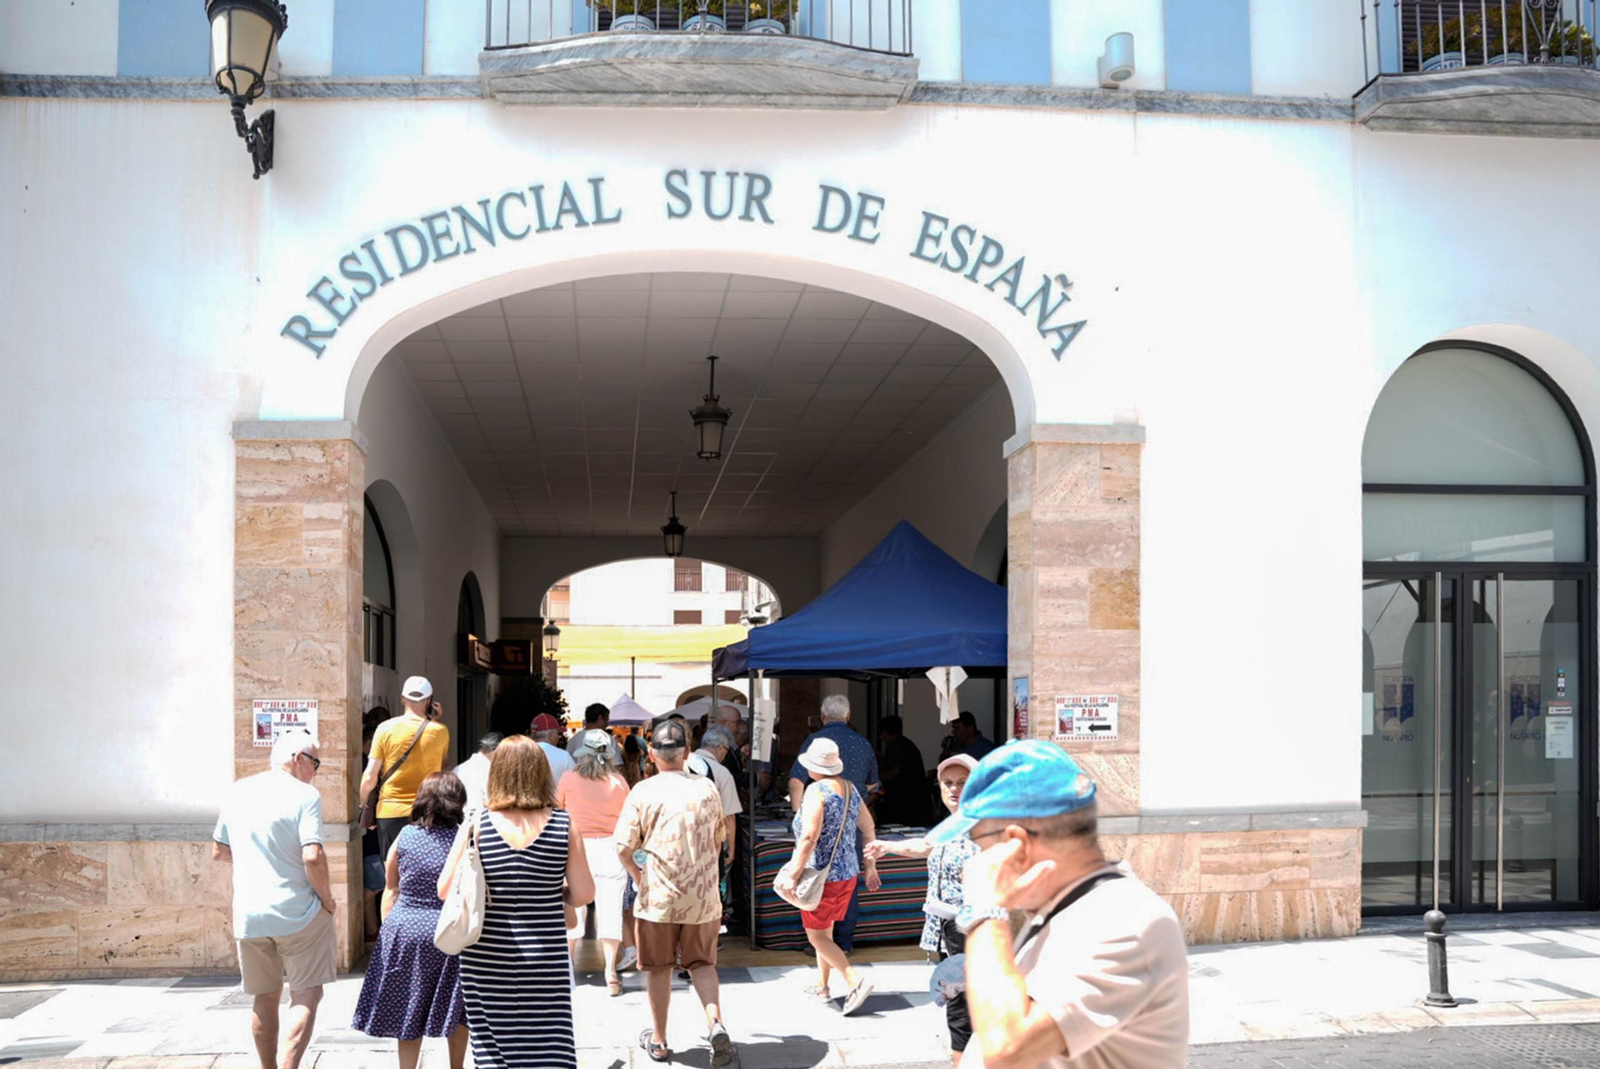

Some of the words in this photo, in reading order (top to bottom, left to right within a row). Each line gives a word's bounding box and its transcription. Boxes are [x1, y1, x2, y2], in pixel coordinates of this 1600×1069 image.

[280, 177, 622, 359] RESIDENCIAL
[664, 168, 775, 224] SUR
[812, 184, 886, 244] DE
[910, 211, 1087, 361] ESPAÑA
[1510, 732, 1541, 740] NOTARIO
